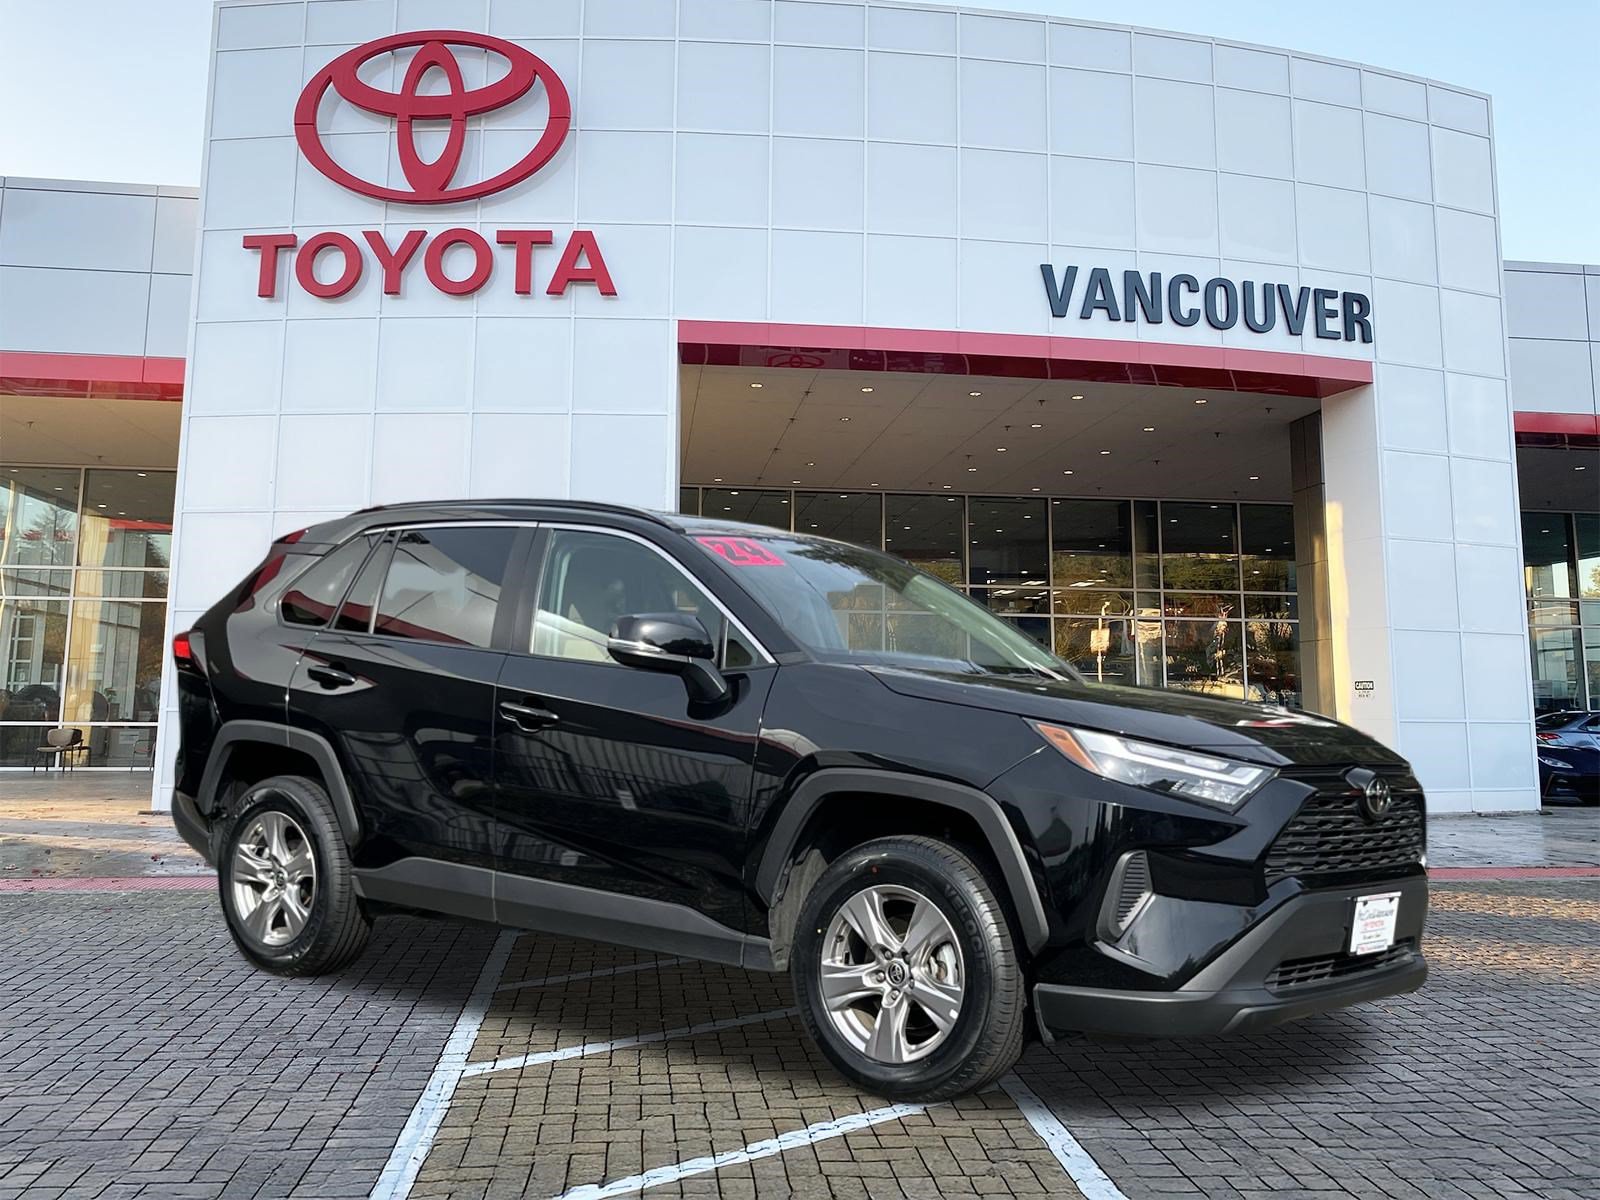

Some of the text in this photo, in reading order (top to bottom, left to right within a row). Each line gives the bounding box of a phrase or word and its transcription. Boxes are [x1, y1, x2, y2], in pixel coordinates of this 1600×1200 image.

[243, 228, 618, 298] TOYOTA
[1040, 264, 1373, 343] VANCOUVER
[707, 541, 772, 561] 24
